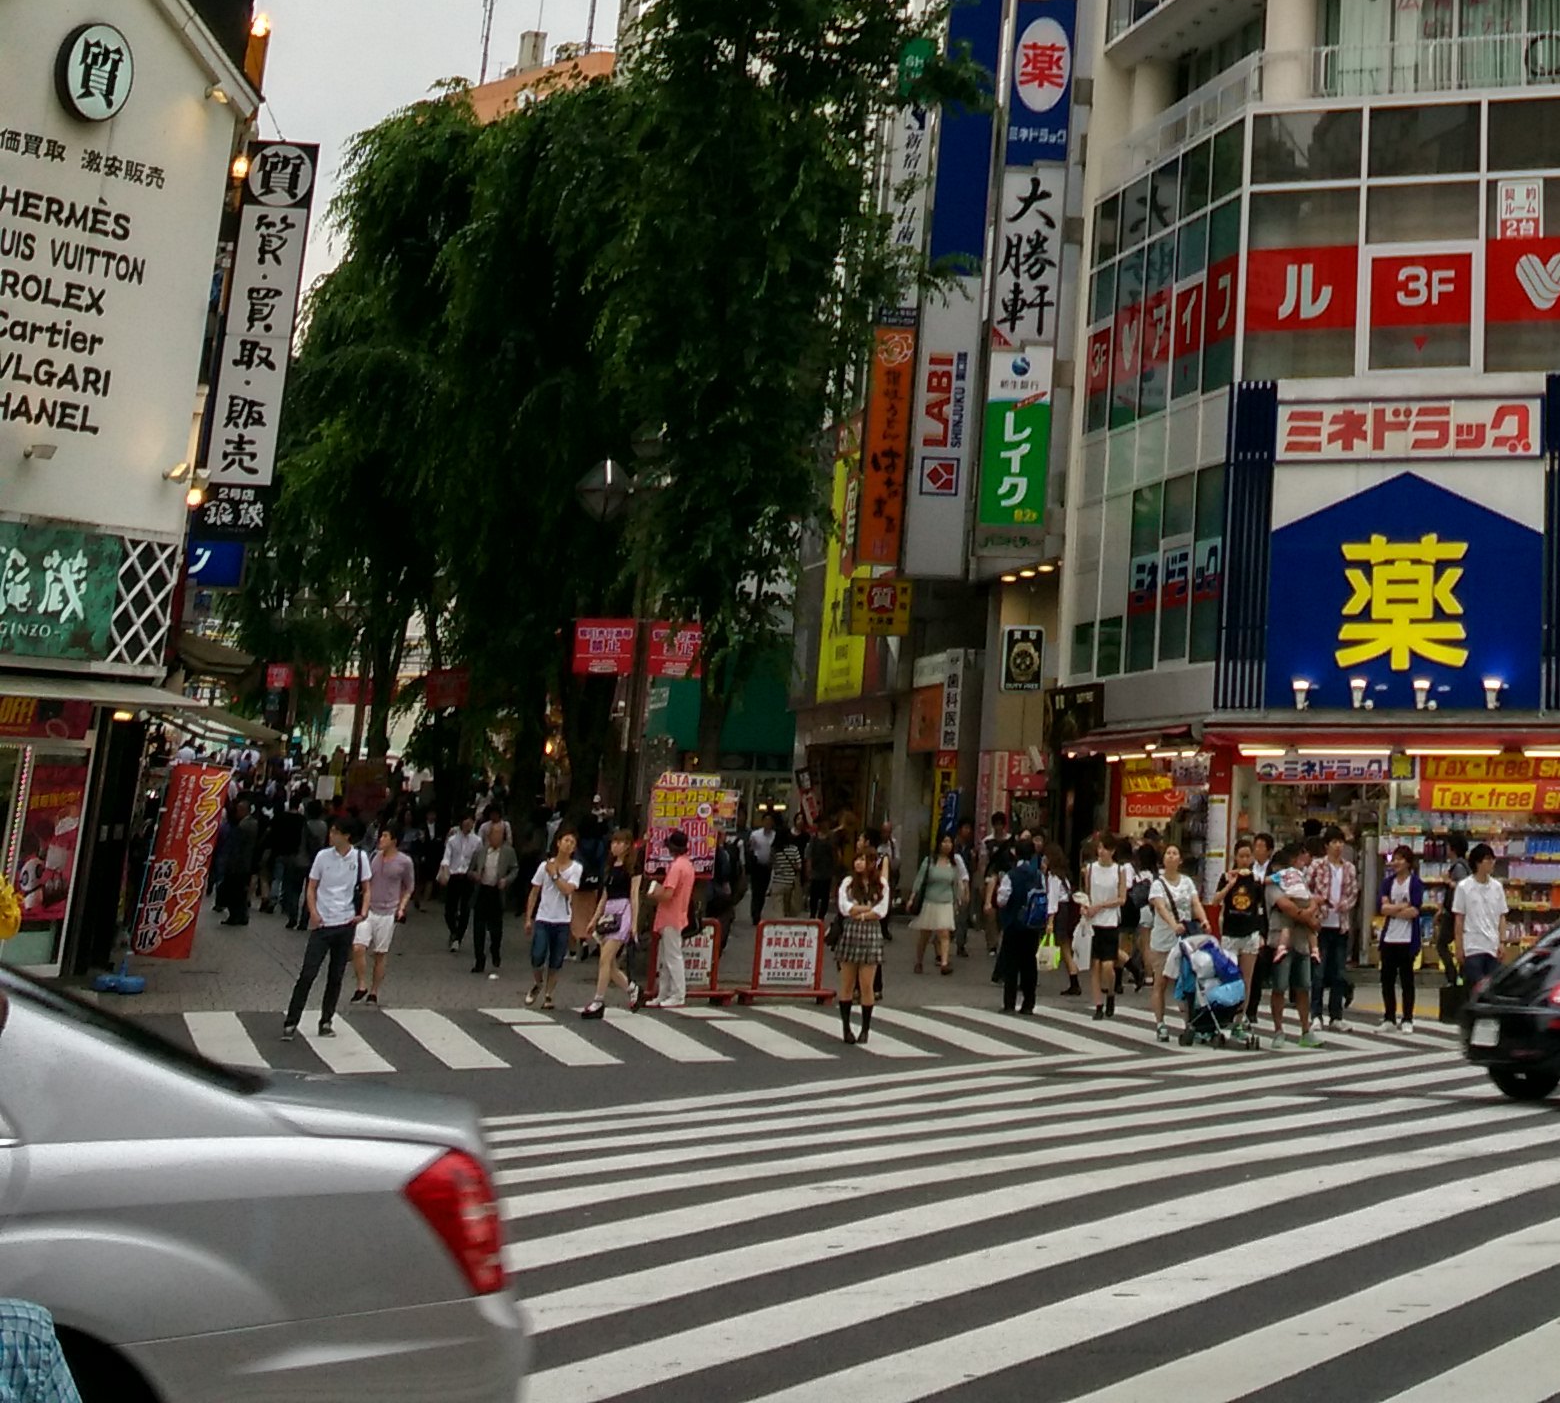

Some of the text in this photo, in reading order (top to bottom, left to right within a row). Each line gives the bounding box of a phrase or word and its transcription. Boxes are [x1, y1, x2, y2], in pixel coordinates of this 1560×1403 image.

[78, 37, 123, 113] 質
[1018, 41, 1067, 91] 薬
[81, 146, 167, 192] 激安販売
[257, 148, 307, 200] 質
[50, 237, 146, 288] VUITTON
[997, 176, 1059, 338] 大勝軒
[0, 266, 106, 317] ROLEX
[1396, 265, 1457, 308] 3F
[922, 351, 955, 450] LABI
[949, 385, 967, 449] SHINJUKU
[997, 409, 1032, 509] レイク
[217, 486, 257, 505] 2号店
[1334, 532, 1470, 672] 薬
